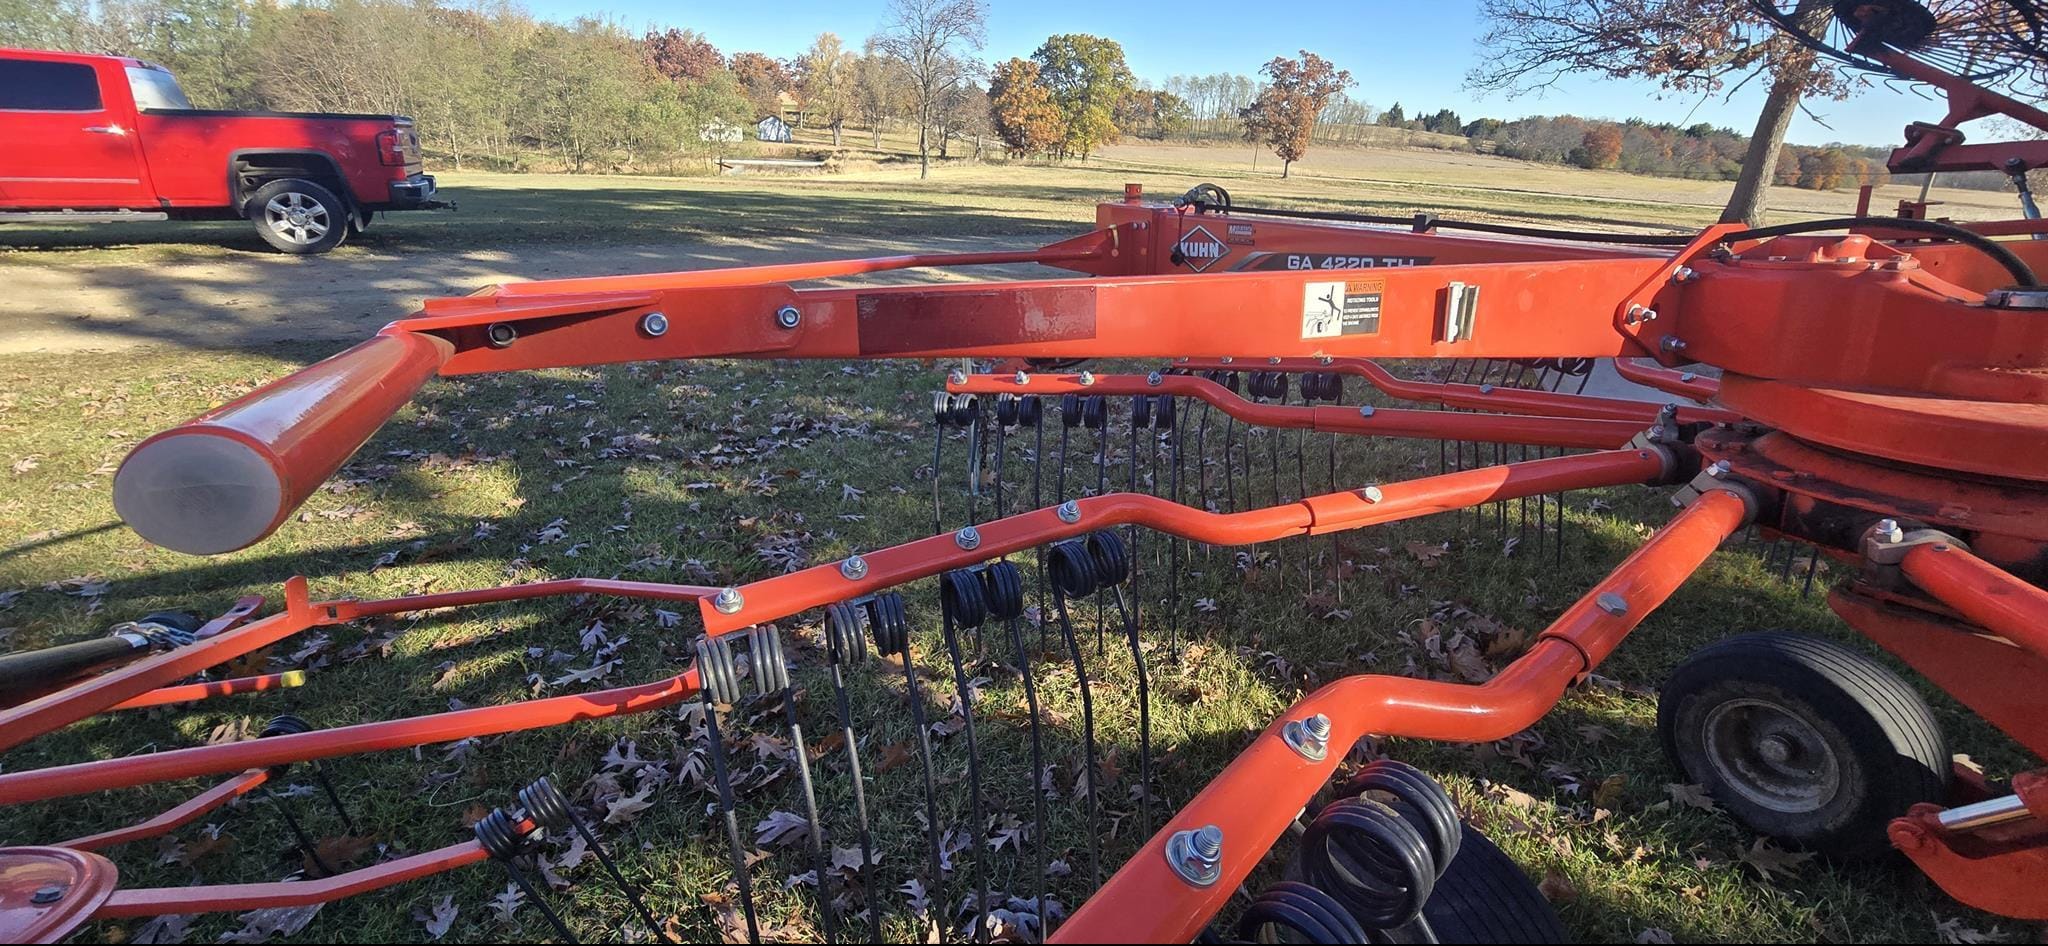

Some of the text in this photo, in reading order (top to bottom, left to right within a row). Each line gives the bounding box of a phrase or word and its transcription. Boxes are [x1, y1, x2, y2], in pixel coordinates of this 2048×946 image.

[1181, 242, 1220, 258] KUHN
[1287, 255, 1313, 270] GA
[1320, 257, 1375, 270] 4220
[1353, 282, 1383, 293] WARNING
